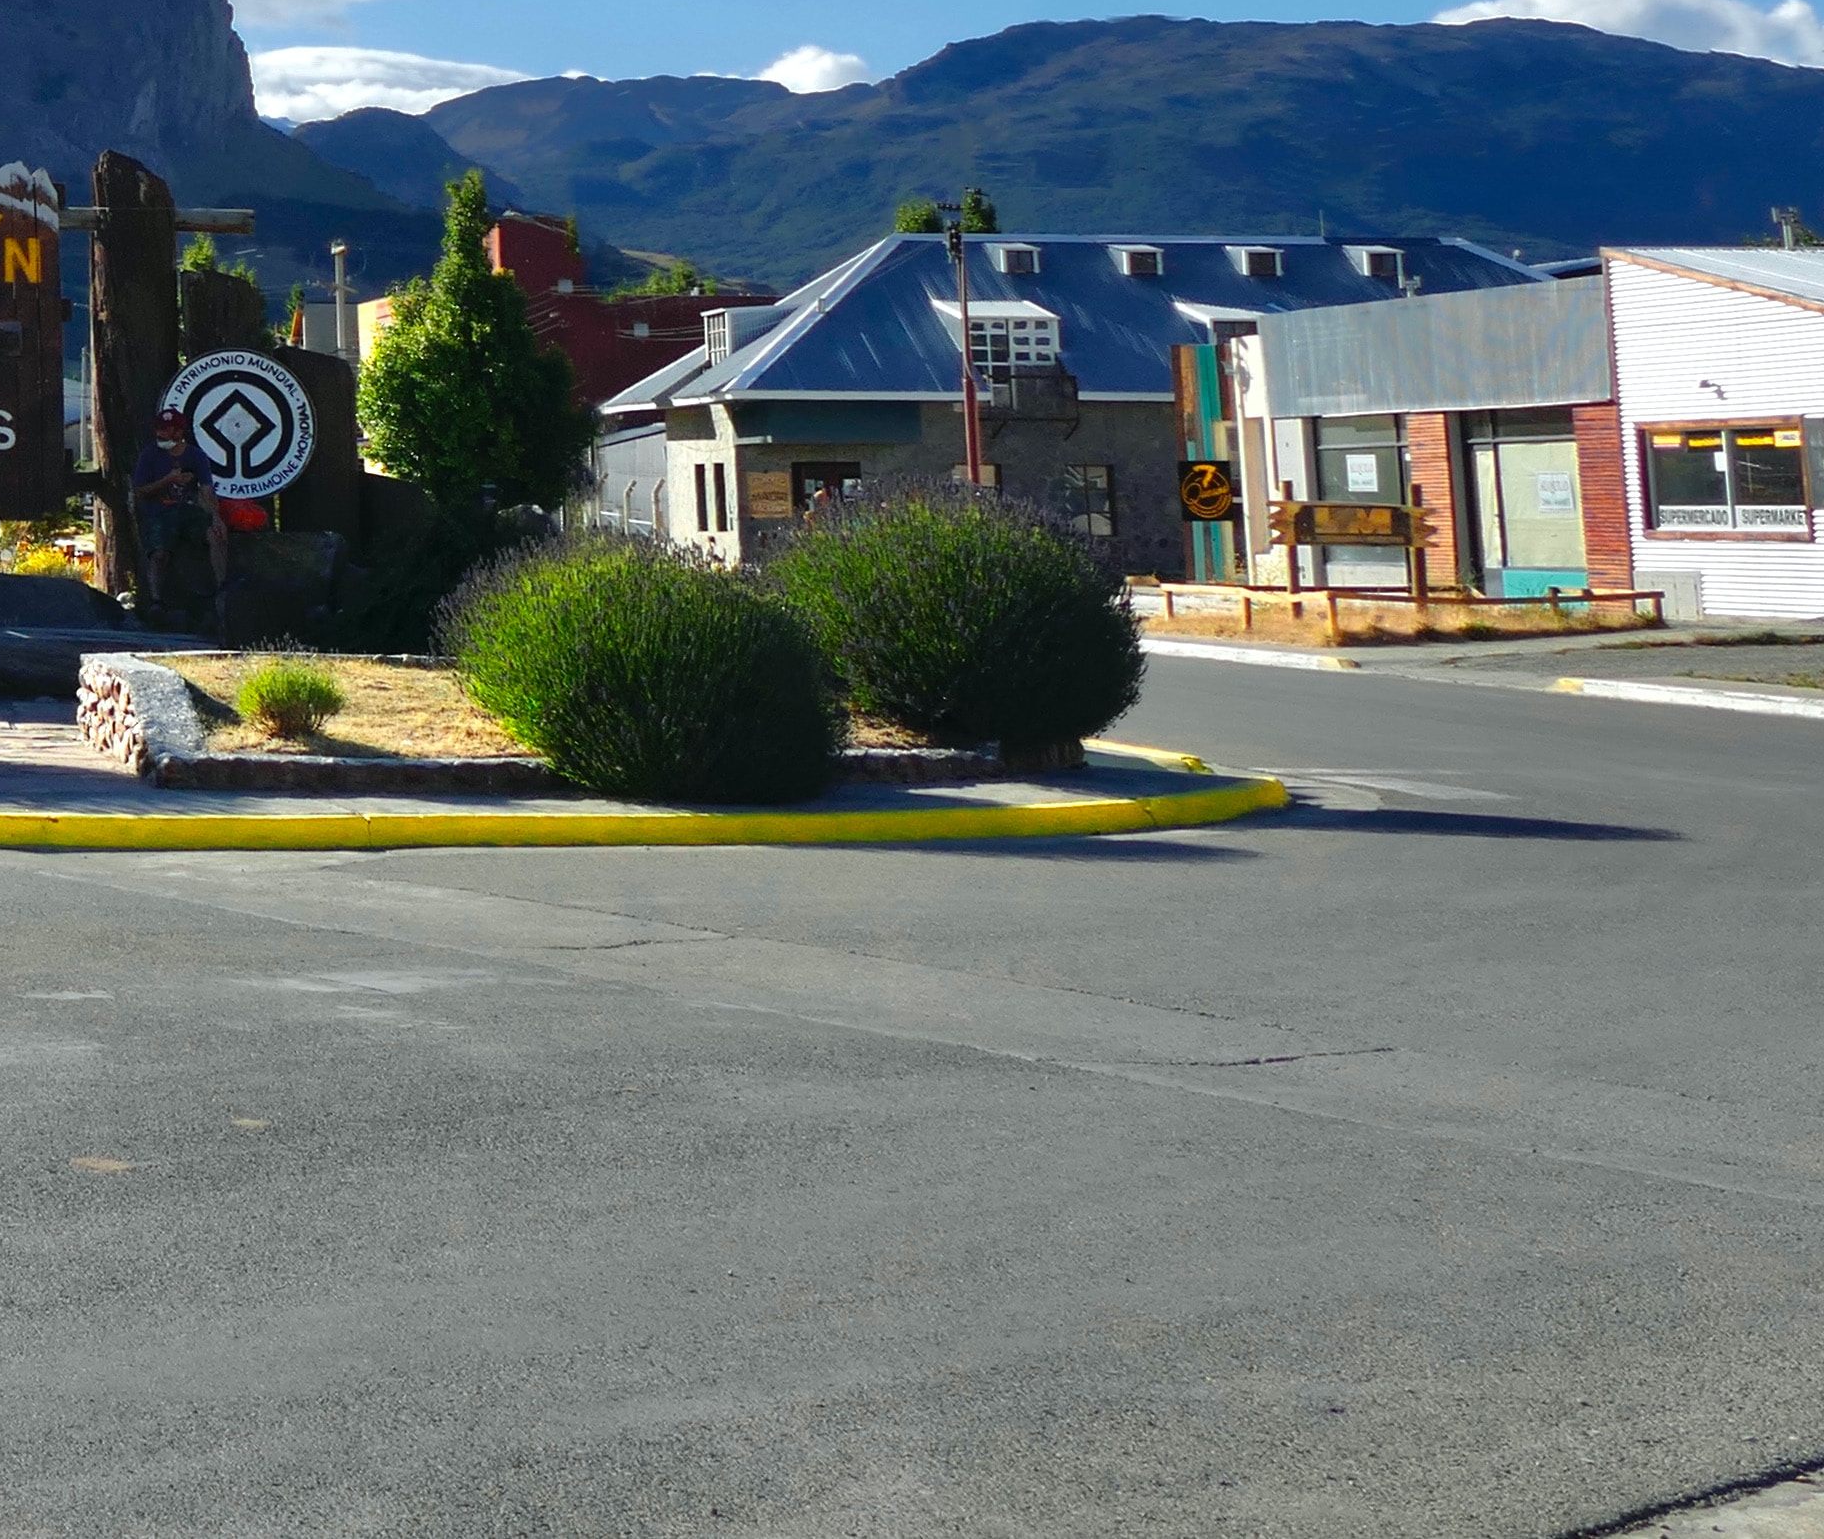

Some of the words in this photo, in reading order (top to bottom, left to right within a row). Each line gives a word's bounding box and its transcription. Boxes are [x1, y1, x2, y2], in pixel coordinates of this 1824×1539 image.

[175, 354, 245, 395] PATRIMONIO
[247, 357, 296, 398] MUNDIAL
[229, 461, 299, 495] PATRIMOINE
[293, 400, 313, 463] MONDIAL
[1659, 509, 1729, 525] SUPERMERCADO
